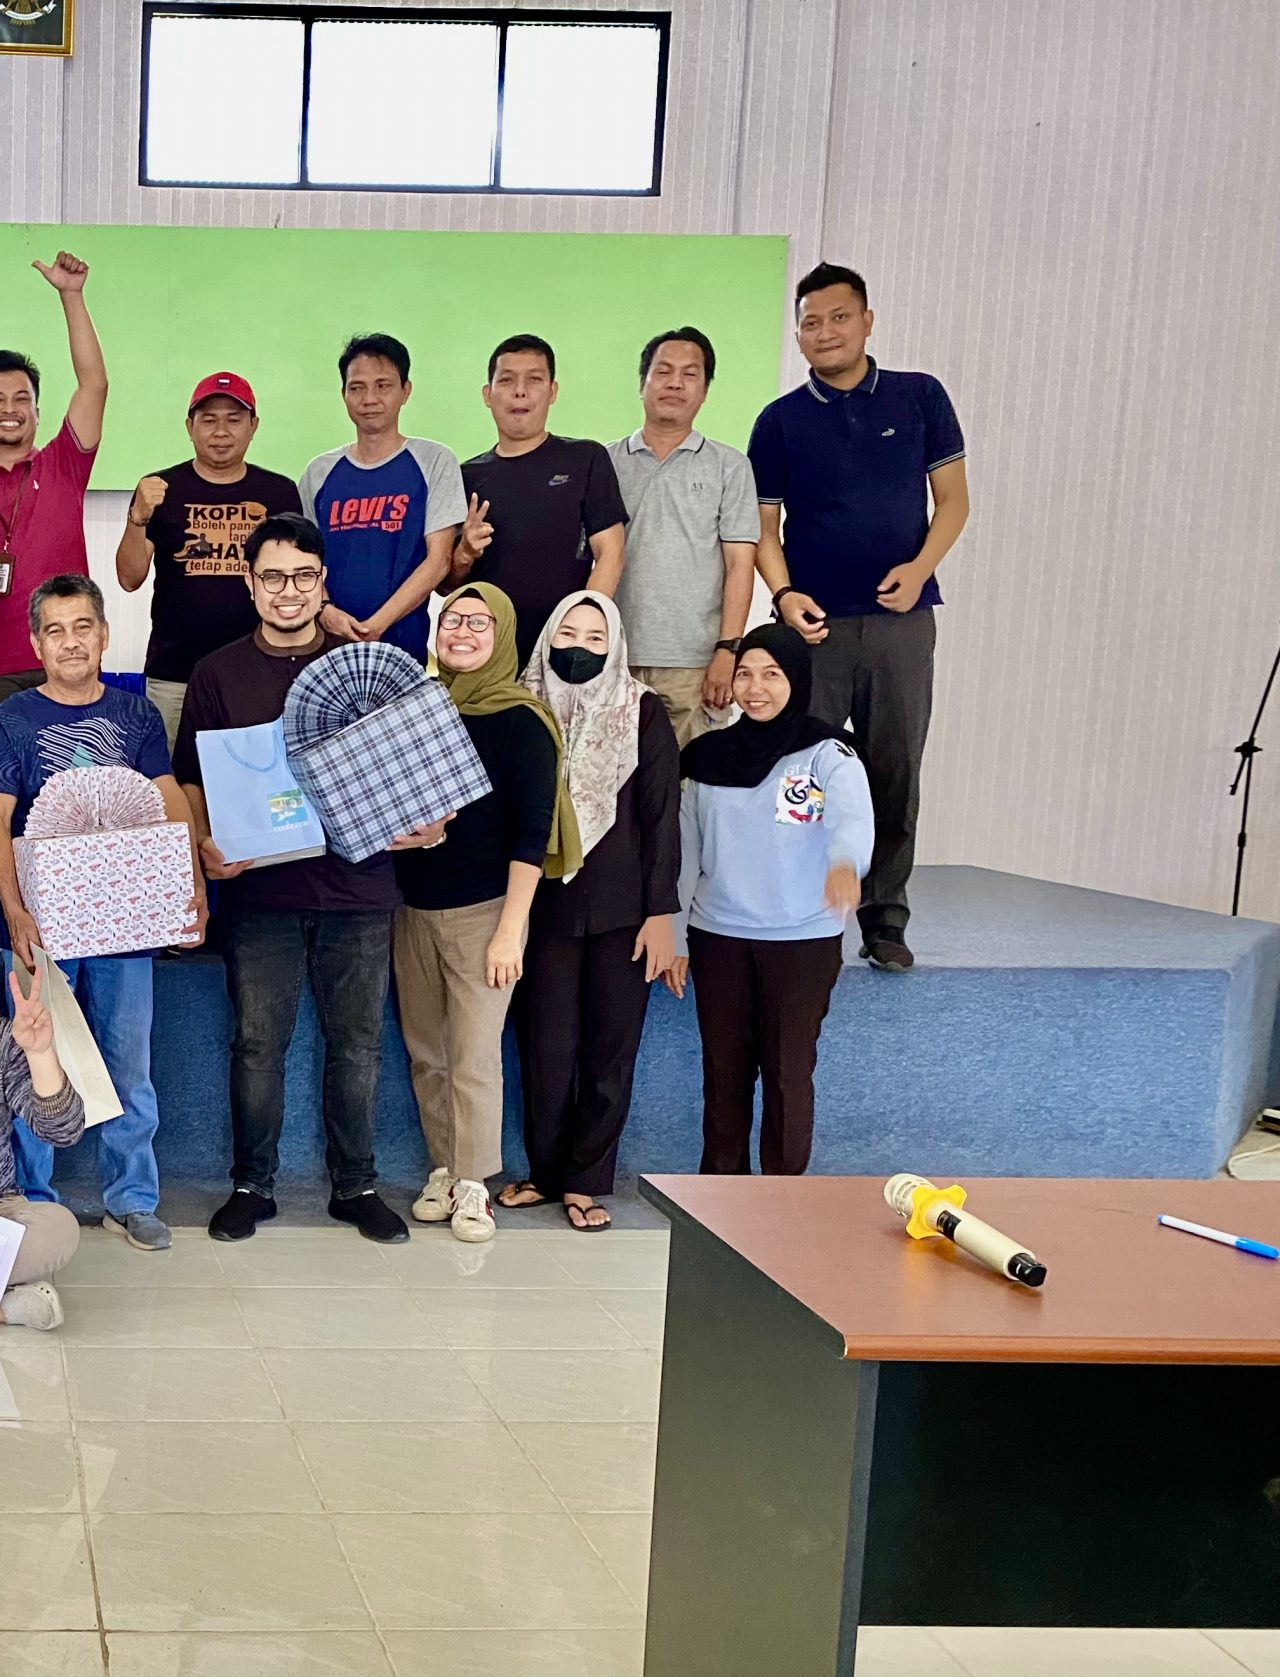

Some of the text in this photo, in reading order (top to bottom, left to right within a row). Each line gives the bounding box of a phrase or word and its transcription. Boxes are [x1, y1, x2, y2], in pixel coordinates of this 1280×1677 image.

[192, 506, 247, 521] KOPI
[192, 520, 257, 533] Boleh pana
[189, 560, 248, 574] tetap ade
